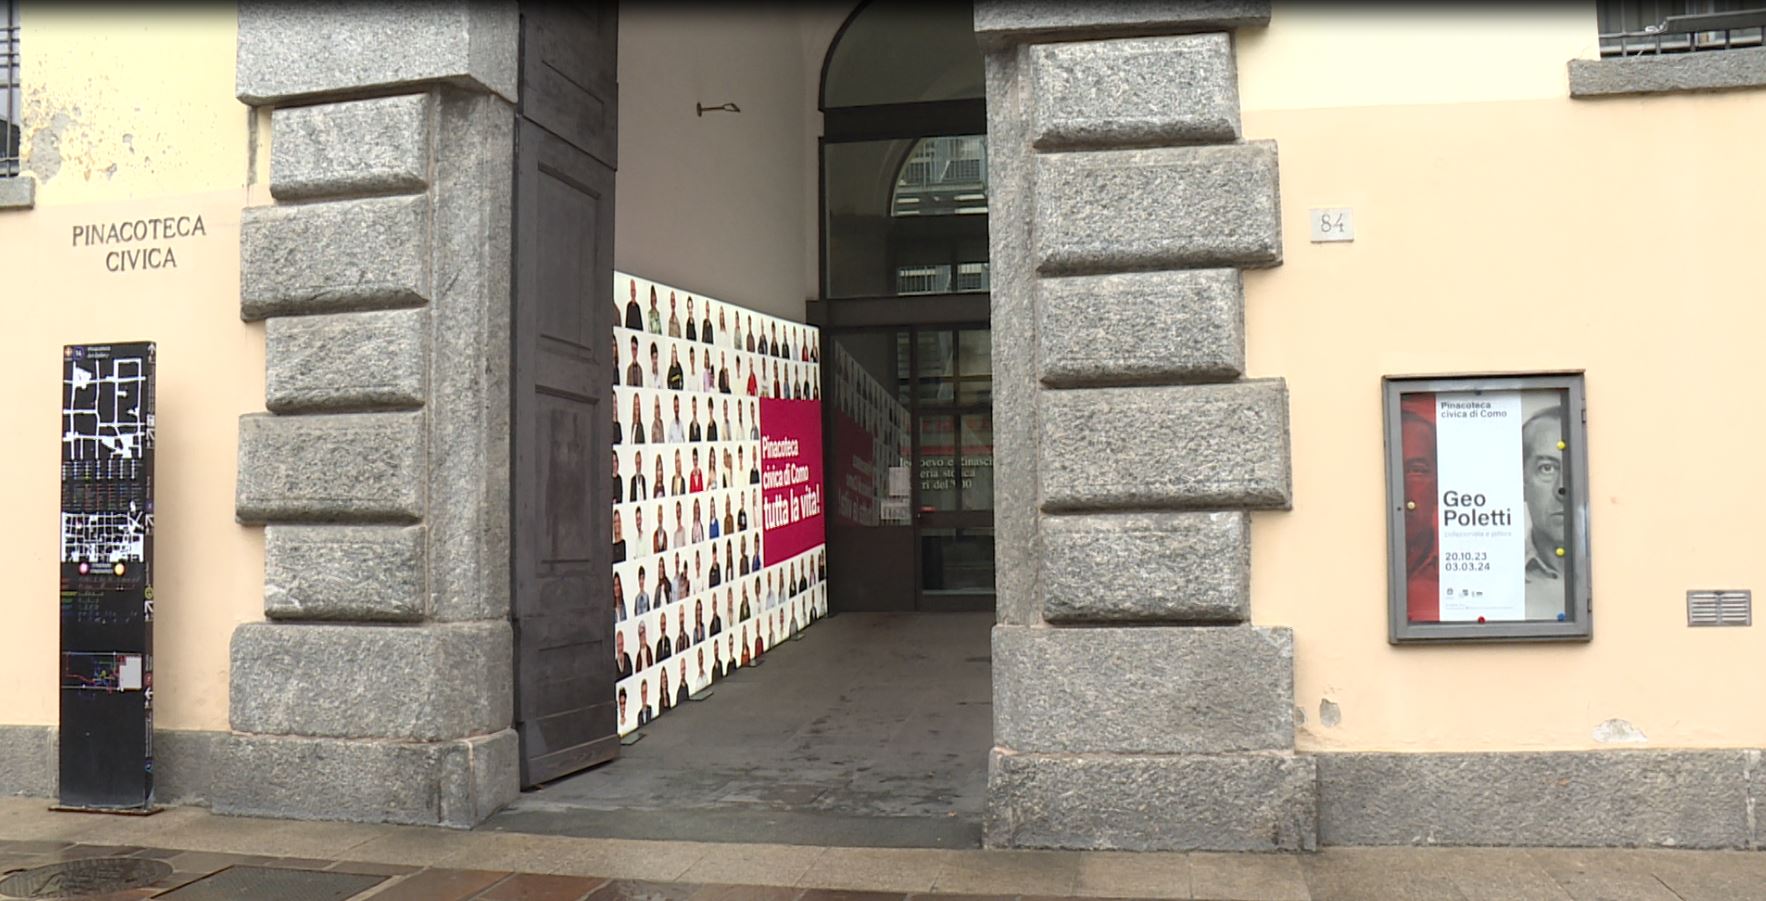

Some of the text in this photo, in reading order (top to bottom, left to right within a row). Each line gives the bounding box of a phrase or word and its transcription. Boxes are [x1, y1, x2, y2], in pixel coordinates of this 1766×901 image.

[72, 214, 207, 247] PINACOTECA
[1320, 212, 1345, 233] 84
[105, 247, 177, 272] CIVICA
[1441, 402, 1491, 410] Pinacoteca
[1441, 410, 1507, 418] civica di Como
[762, 435, 799, 460] Pinacoteca
[763, 463, 809, 490] civica di Como
[764, 494, 789, 531] tutta
[790, 488, 800, 523] la
[800, 483, 821, 519] vita!
[1443, 490, 1487, 507] Geo
[1444, 508, 1511, 527] Poletti
[1445, 552, 1488, 561] 20.10.23
[1445, 562, 1491, 571] 03.03.24
